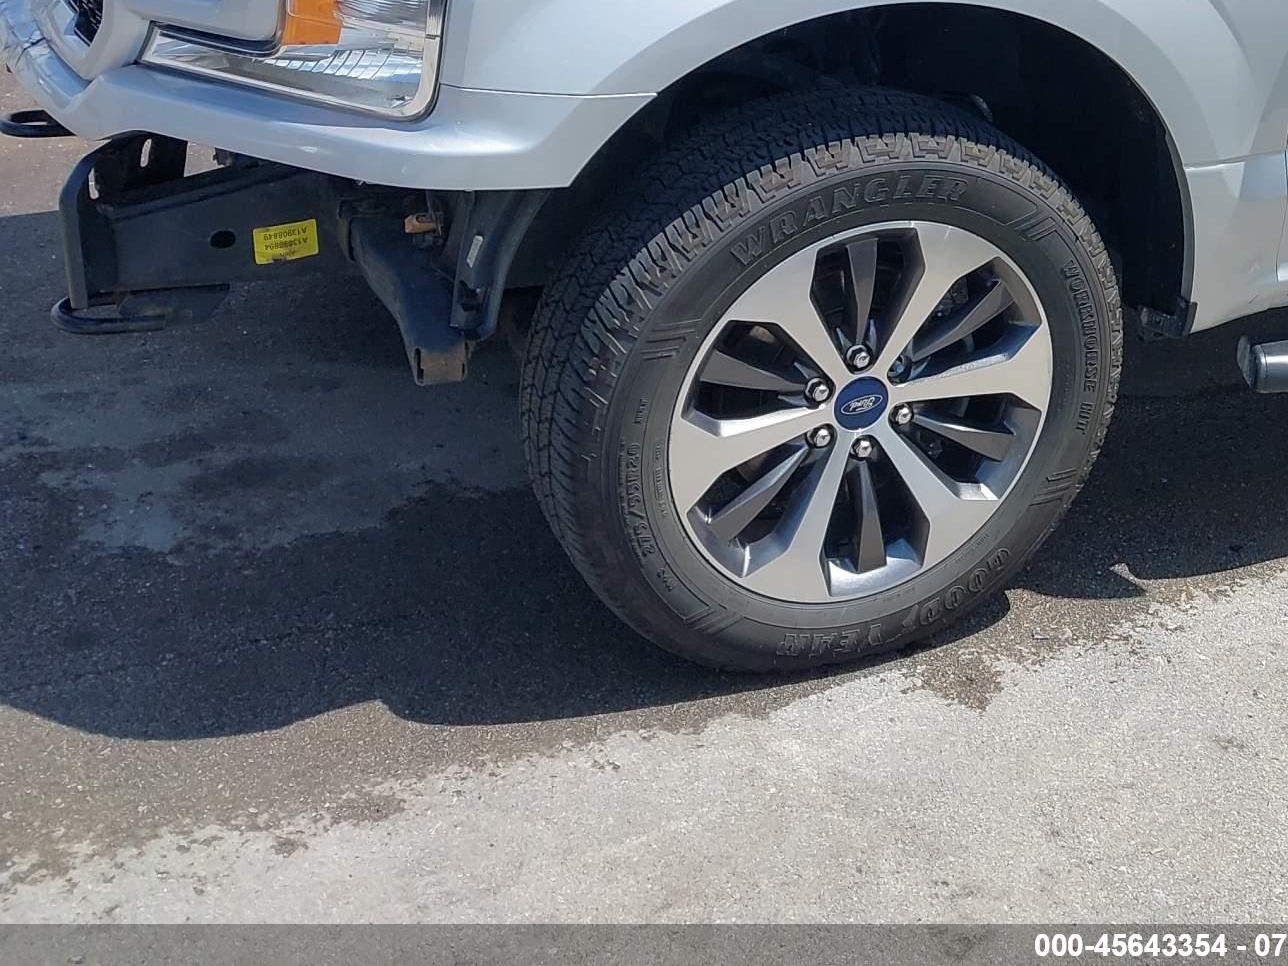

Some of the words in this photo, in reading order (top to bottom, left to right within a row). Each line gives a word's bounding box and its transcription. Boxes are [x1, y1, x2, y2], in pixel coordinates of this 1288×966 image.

[730, 174, 969, 266] WRANGLER
[1062, 259, 1099, 393] WORKHORSE
[847, 395, 877, 412] Ford
